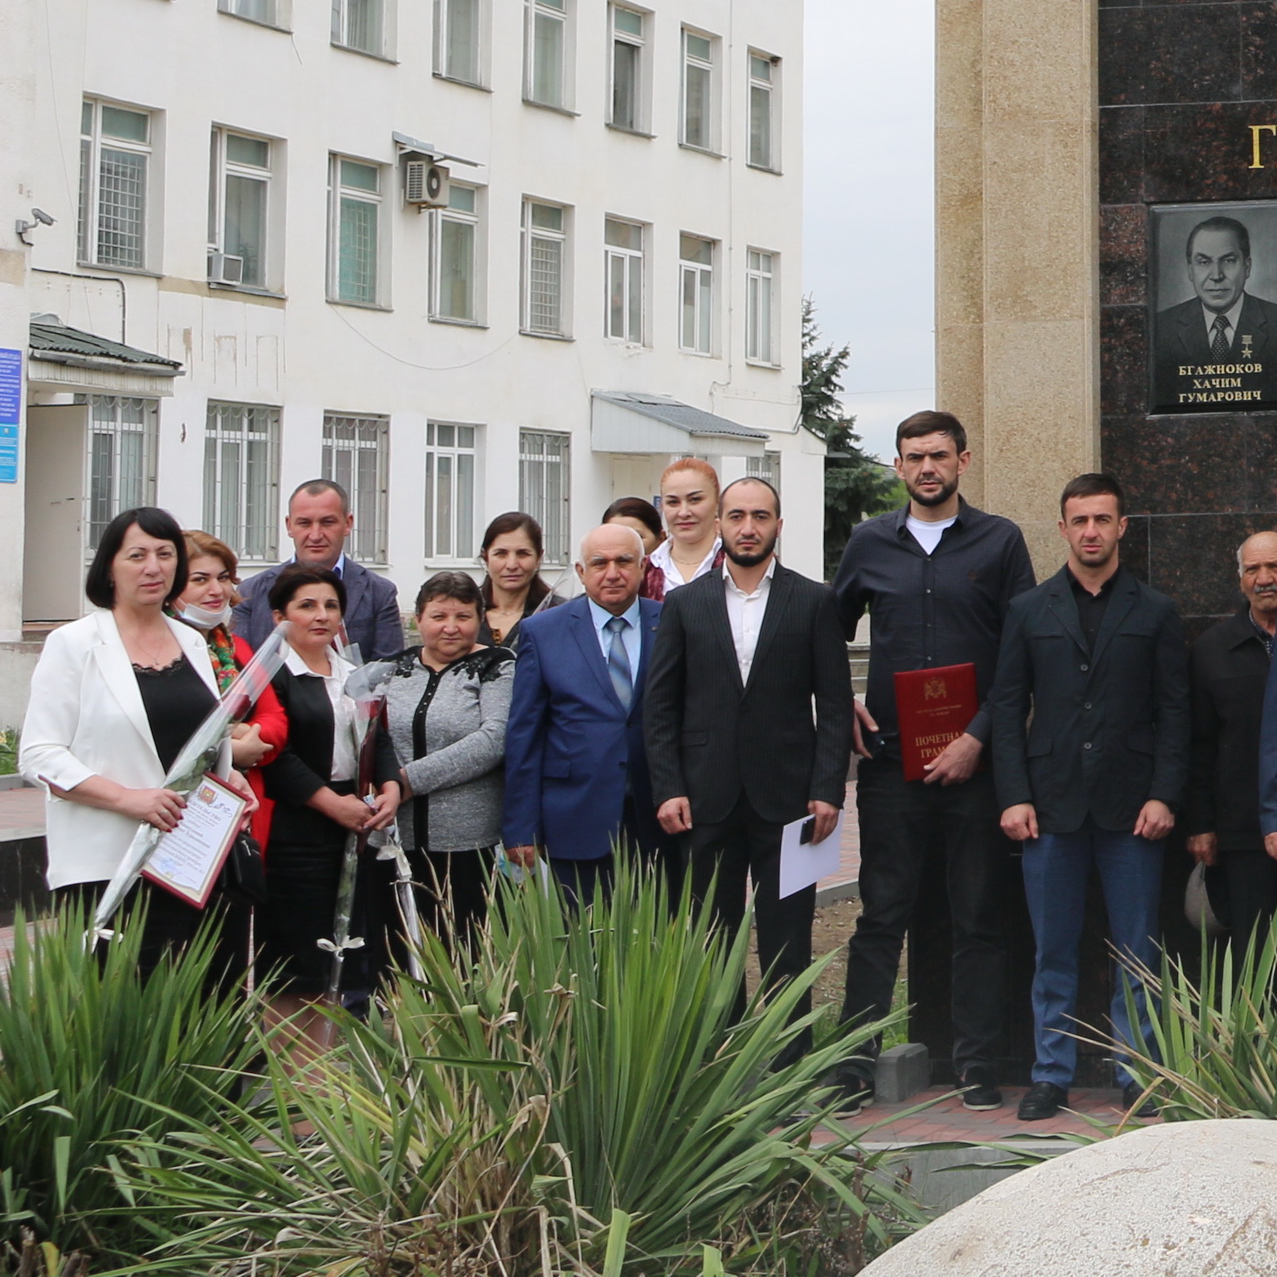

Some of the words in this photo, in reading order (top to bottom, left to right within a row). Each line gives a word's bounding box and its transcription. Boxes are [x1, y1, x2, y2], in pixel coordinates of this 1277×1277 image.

[1178, 363, 1263, 376] БГАЖНОКОВ
[1193, 377, 1242, 389] ХАЧИМ
[1178, 390, 1262, 403] ГУМАРОВИЧ
[915, 731, 963, 747] ПОЧЕТНА
[921, 746, 948, 759] ГРАМ
